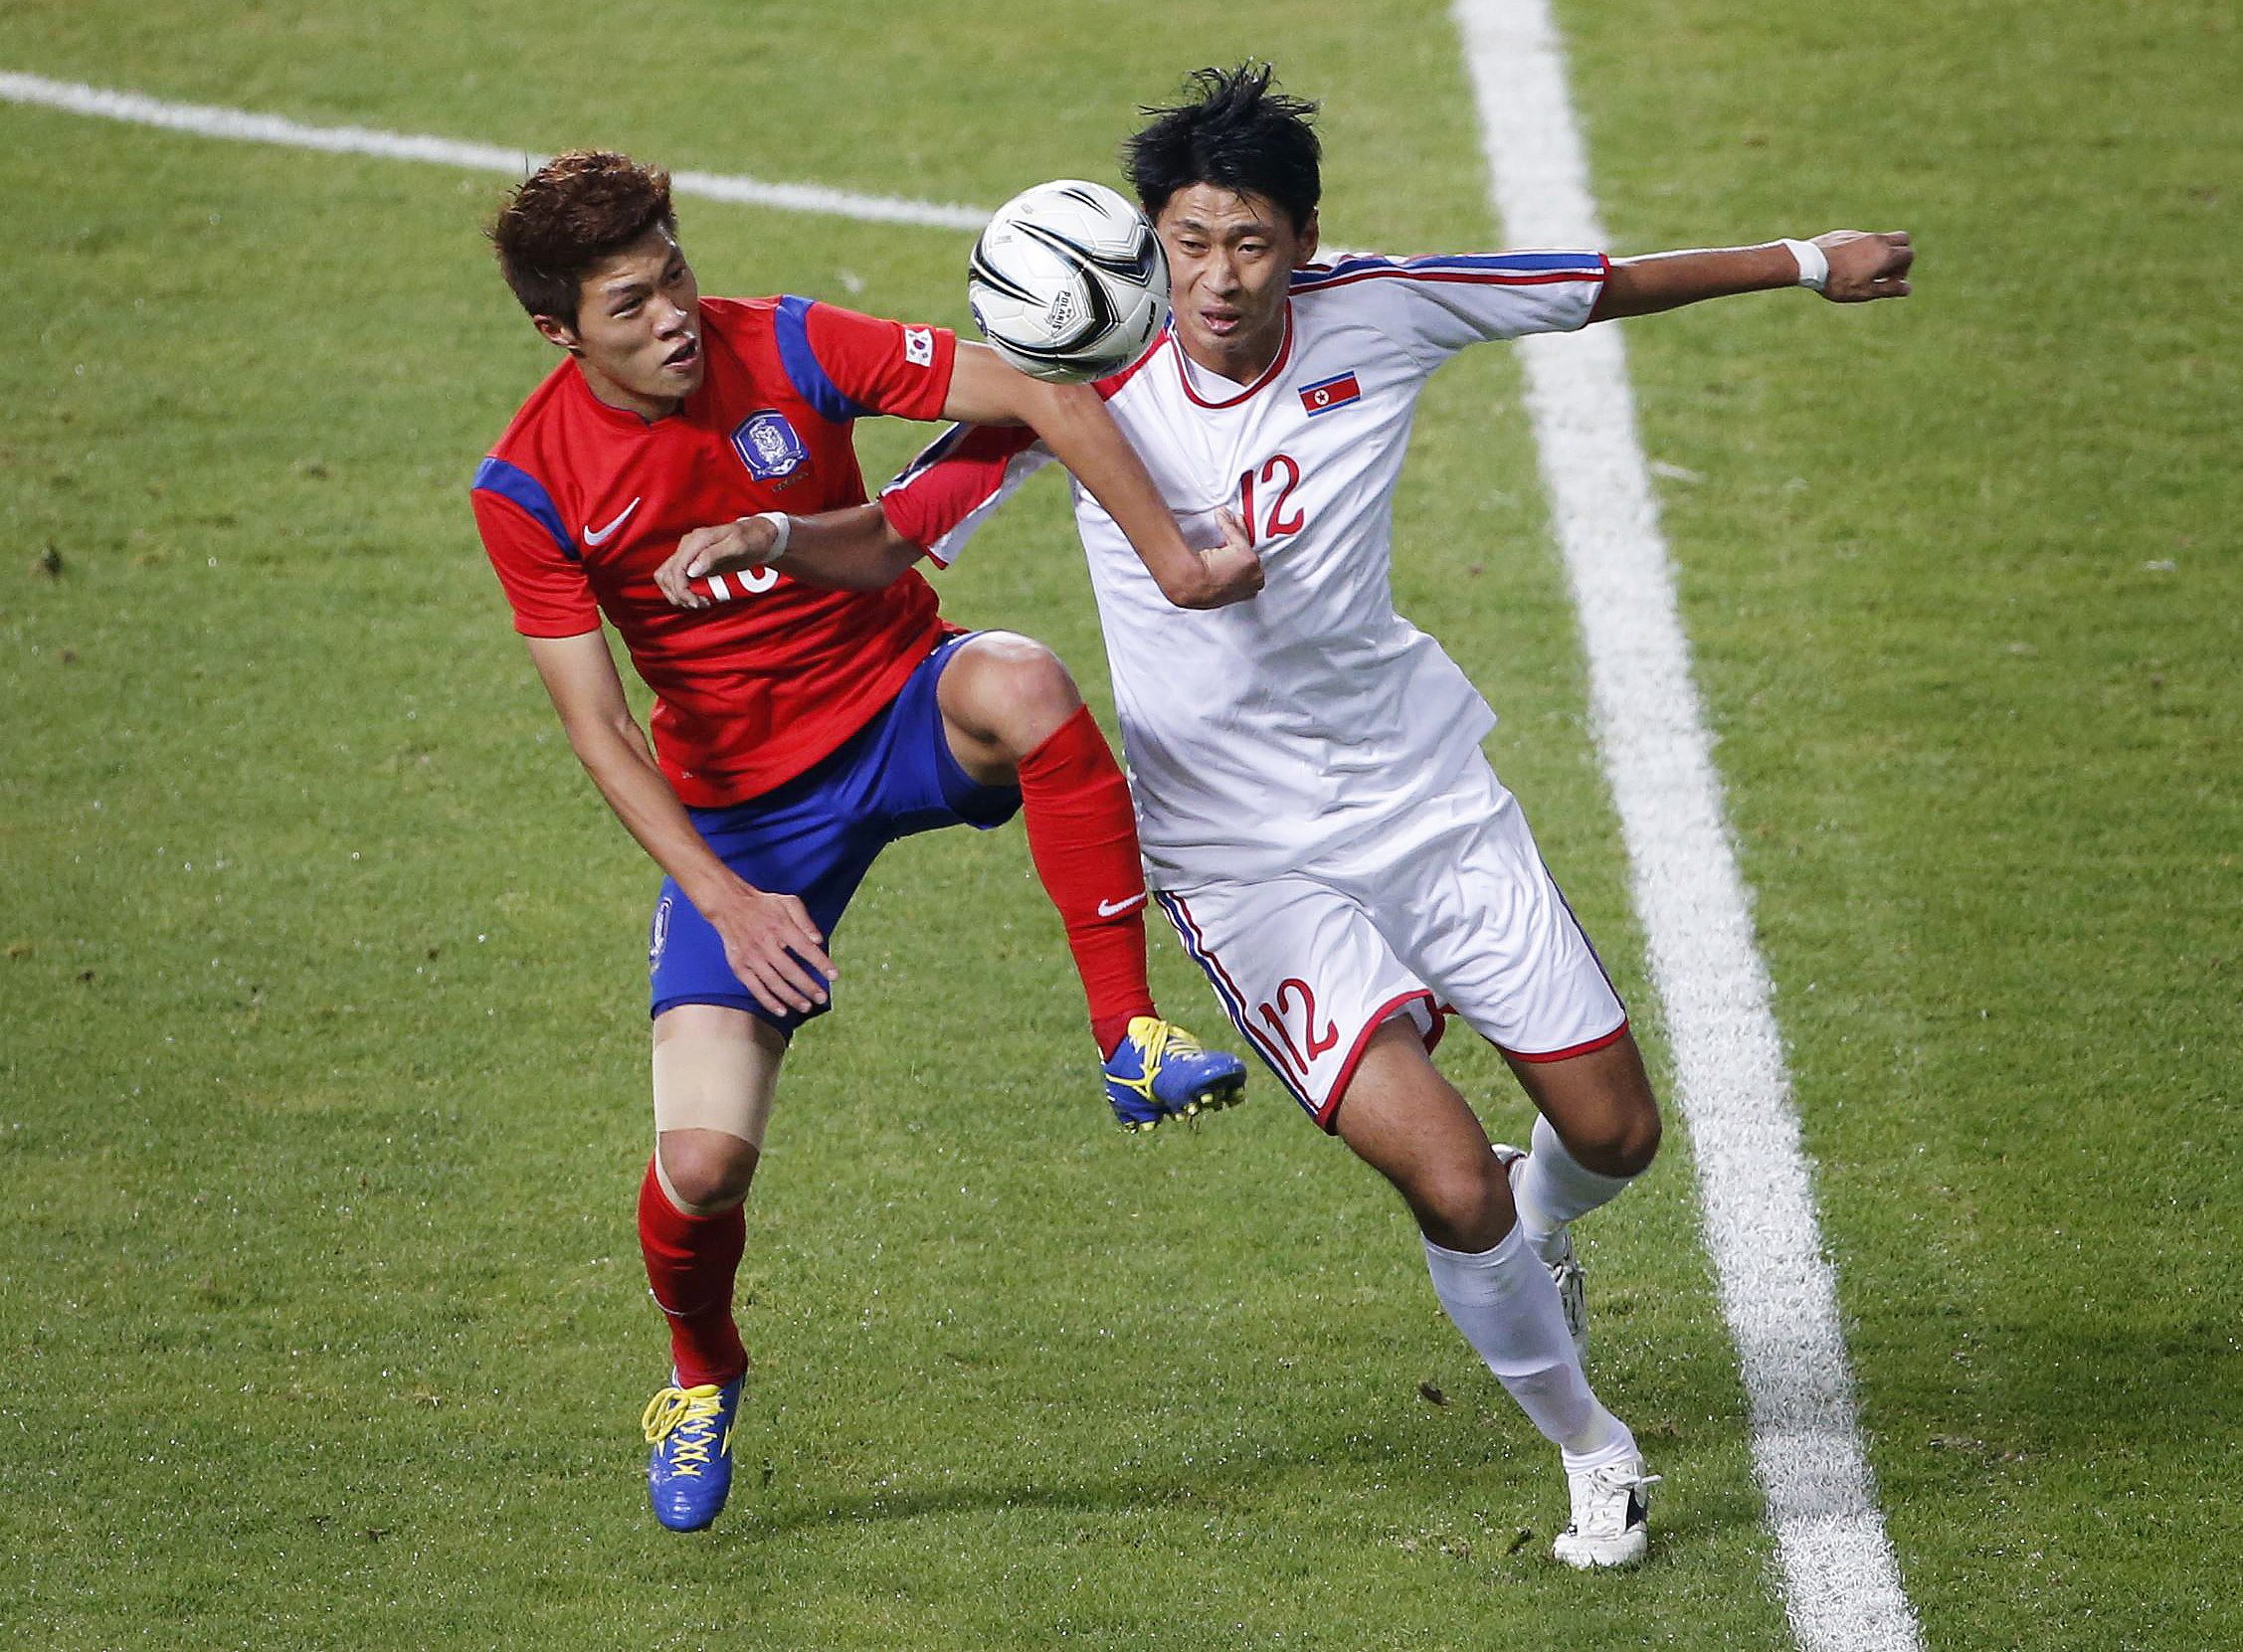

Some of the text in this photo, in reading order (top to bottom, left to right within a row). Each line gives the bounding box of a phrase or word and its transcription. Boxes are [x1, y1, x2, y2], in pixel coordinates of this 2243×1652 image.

[1051, 289, 1071, 330] POLARIS
[1239, 454, 1305, 548] 12
[1258, 978, 1339, 1075] 12
